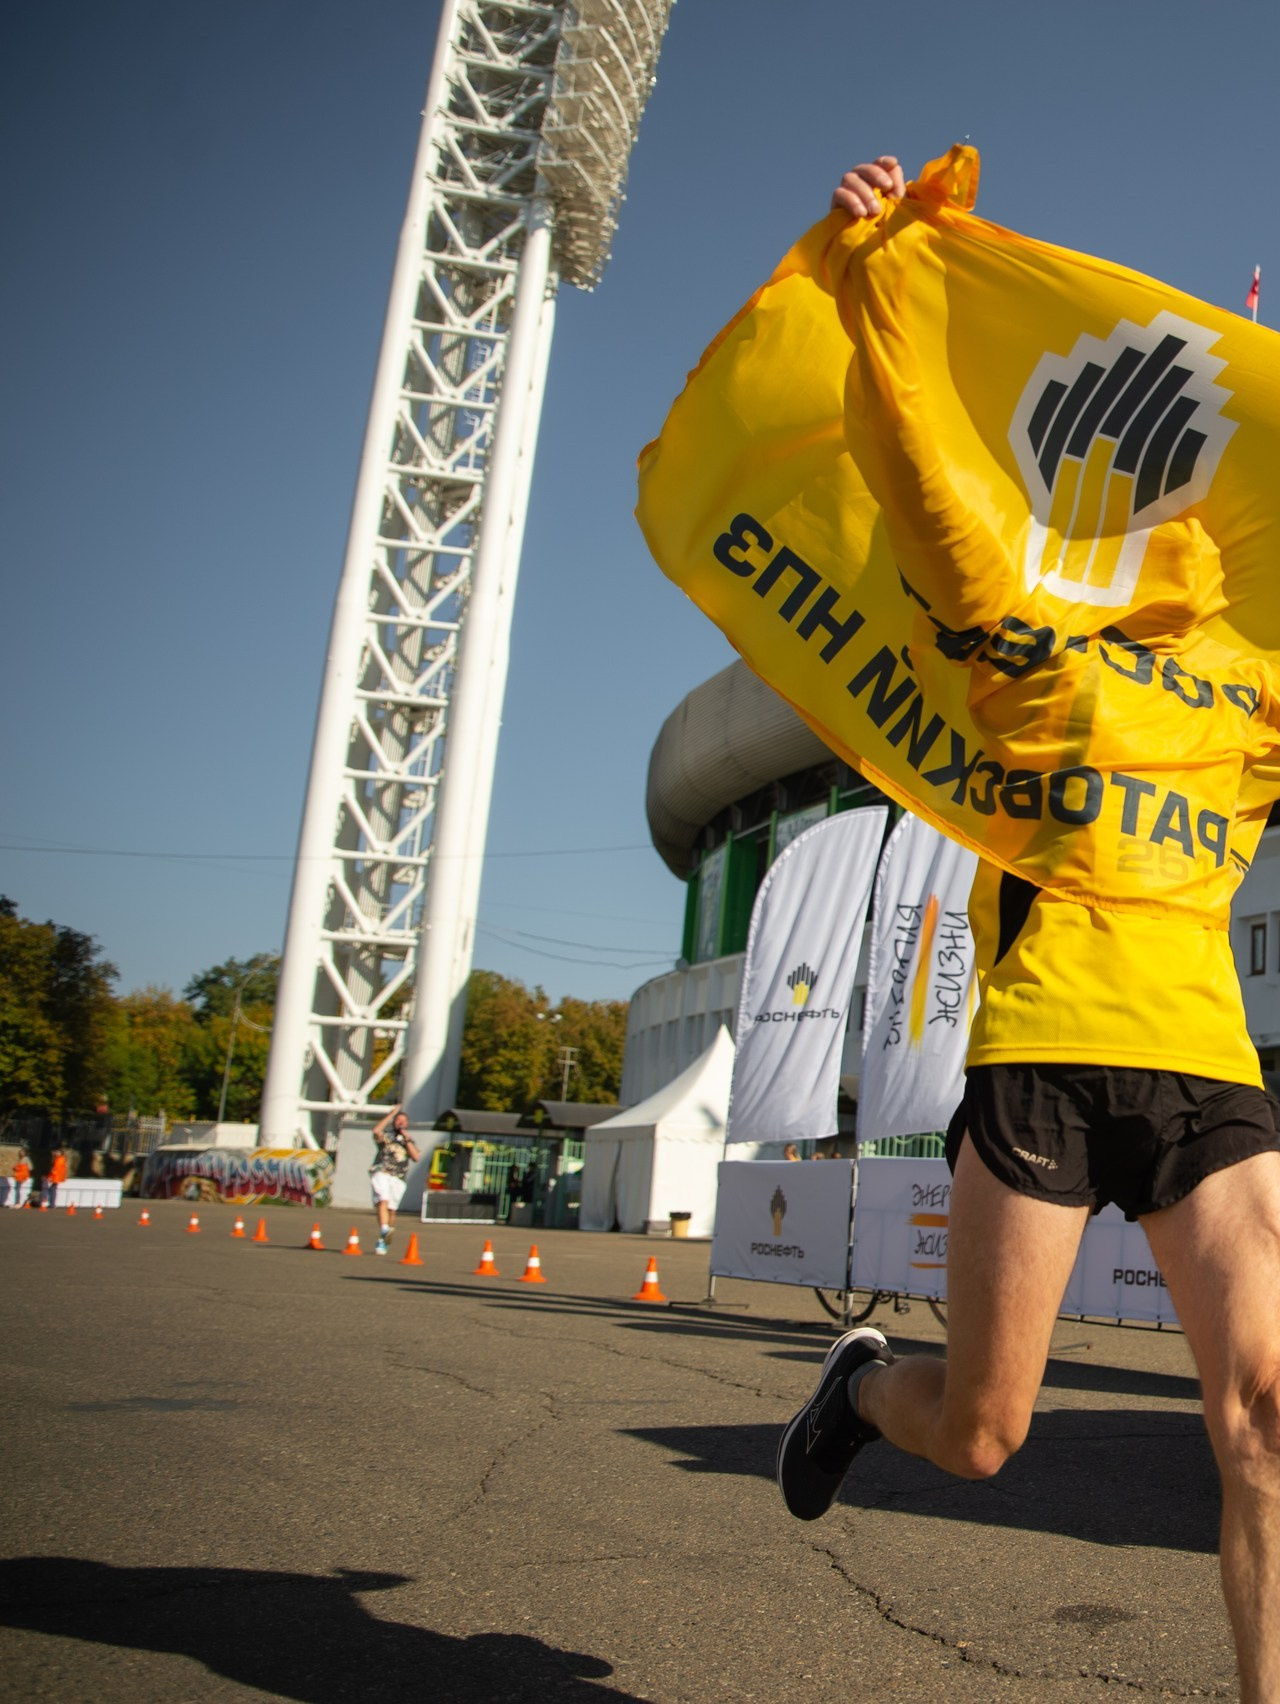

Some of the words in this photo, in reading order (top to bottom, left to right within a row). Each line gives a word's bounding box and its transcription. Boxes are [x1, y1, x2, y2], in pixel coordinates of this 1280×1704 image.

[928, 910, 968, 1028] ЖИЗНИ
[1012, 1146, 1050, 1167] CRAFT
[911, 1183, 952, 1208] ЭНЕР
[751, 1242, 805, 1259] РОСНЕФТЬ
